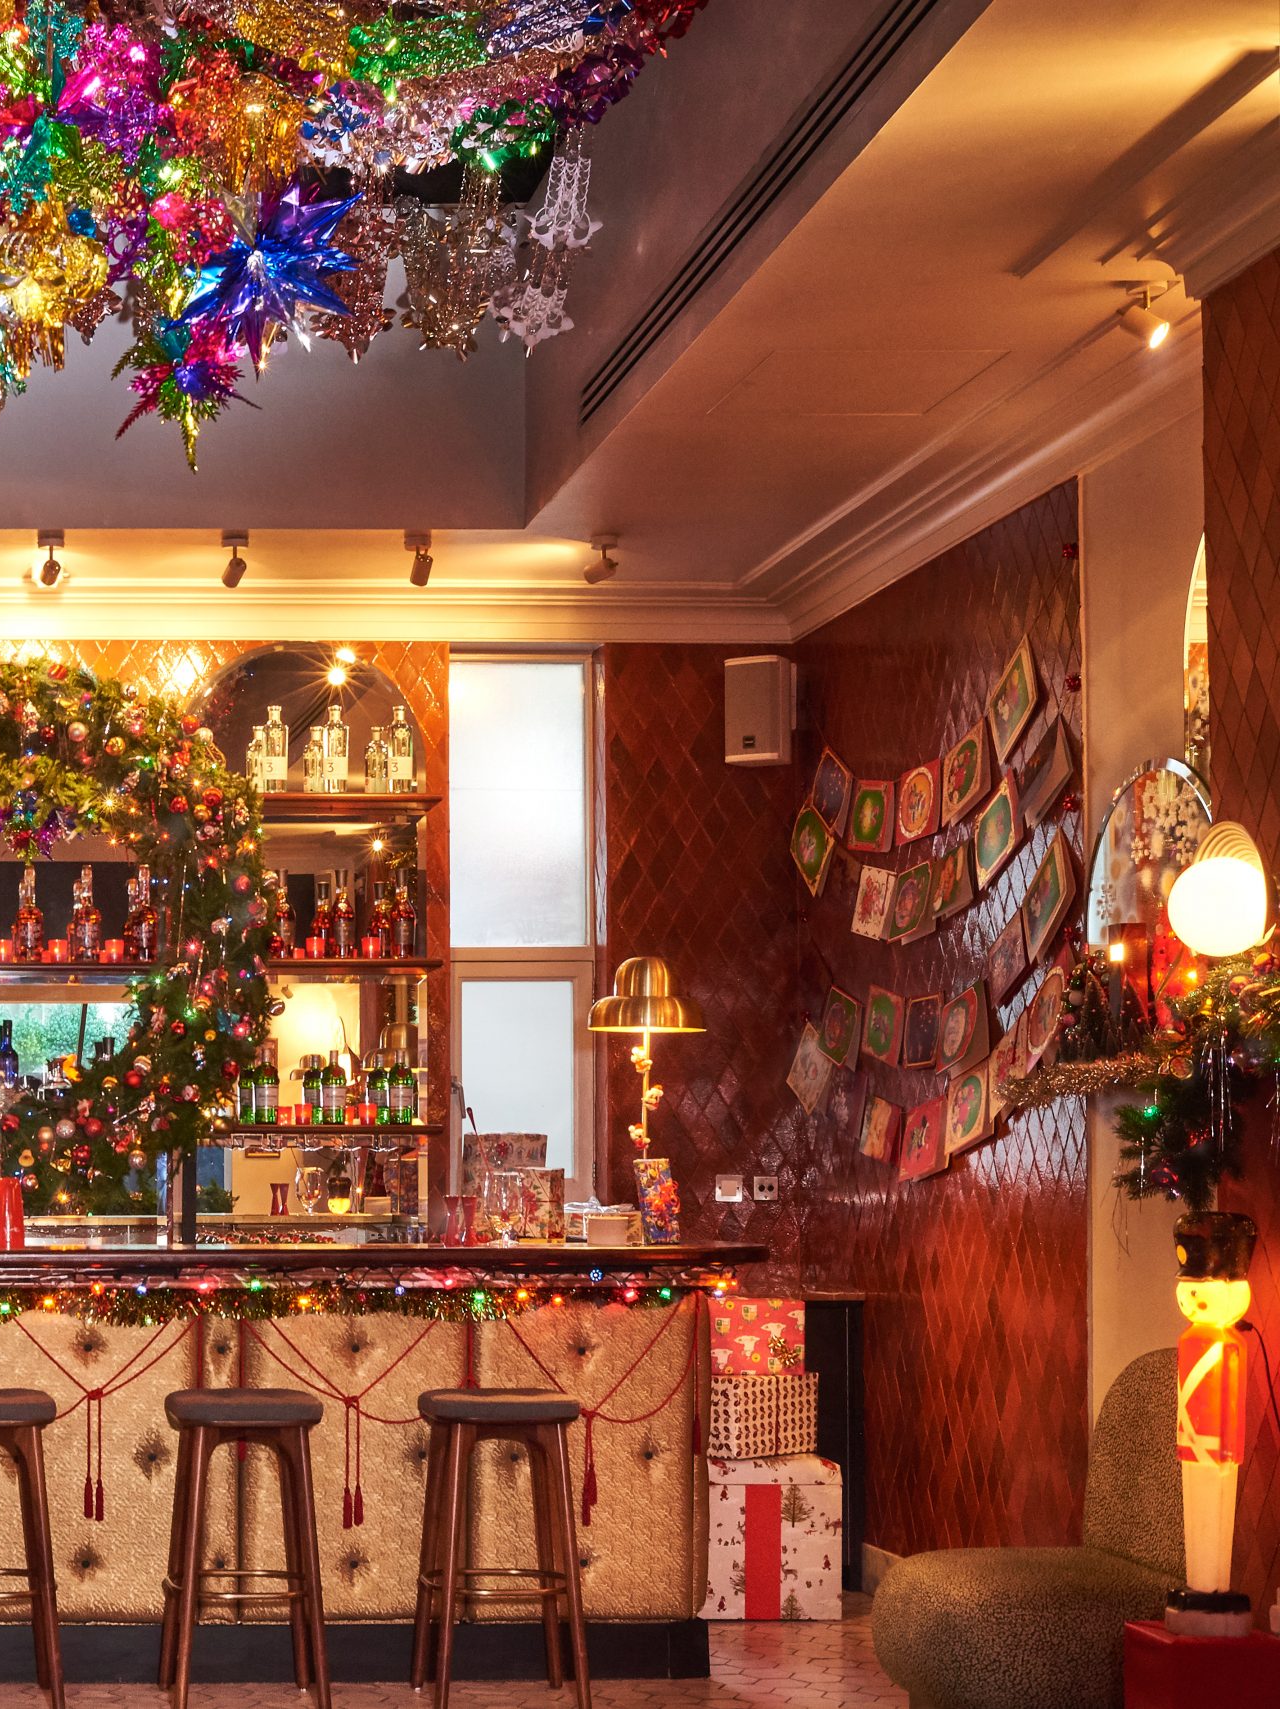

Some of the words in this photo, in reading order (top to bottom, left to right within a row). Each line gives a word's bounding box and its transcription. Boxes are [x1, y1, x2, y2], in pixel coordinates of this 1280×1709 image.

[266, 762, 273, 773] 3
[327, 762, 334, 773] 3
[391, 762, 399, 773] 3
